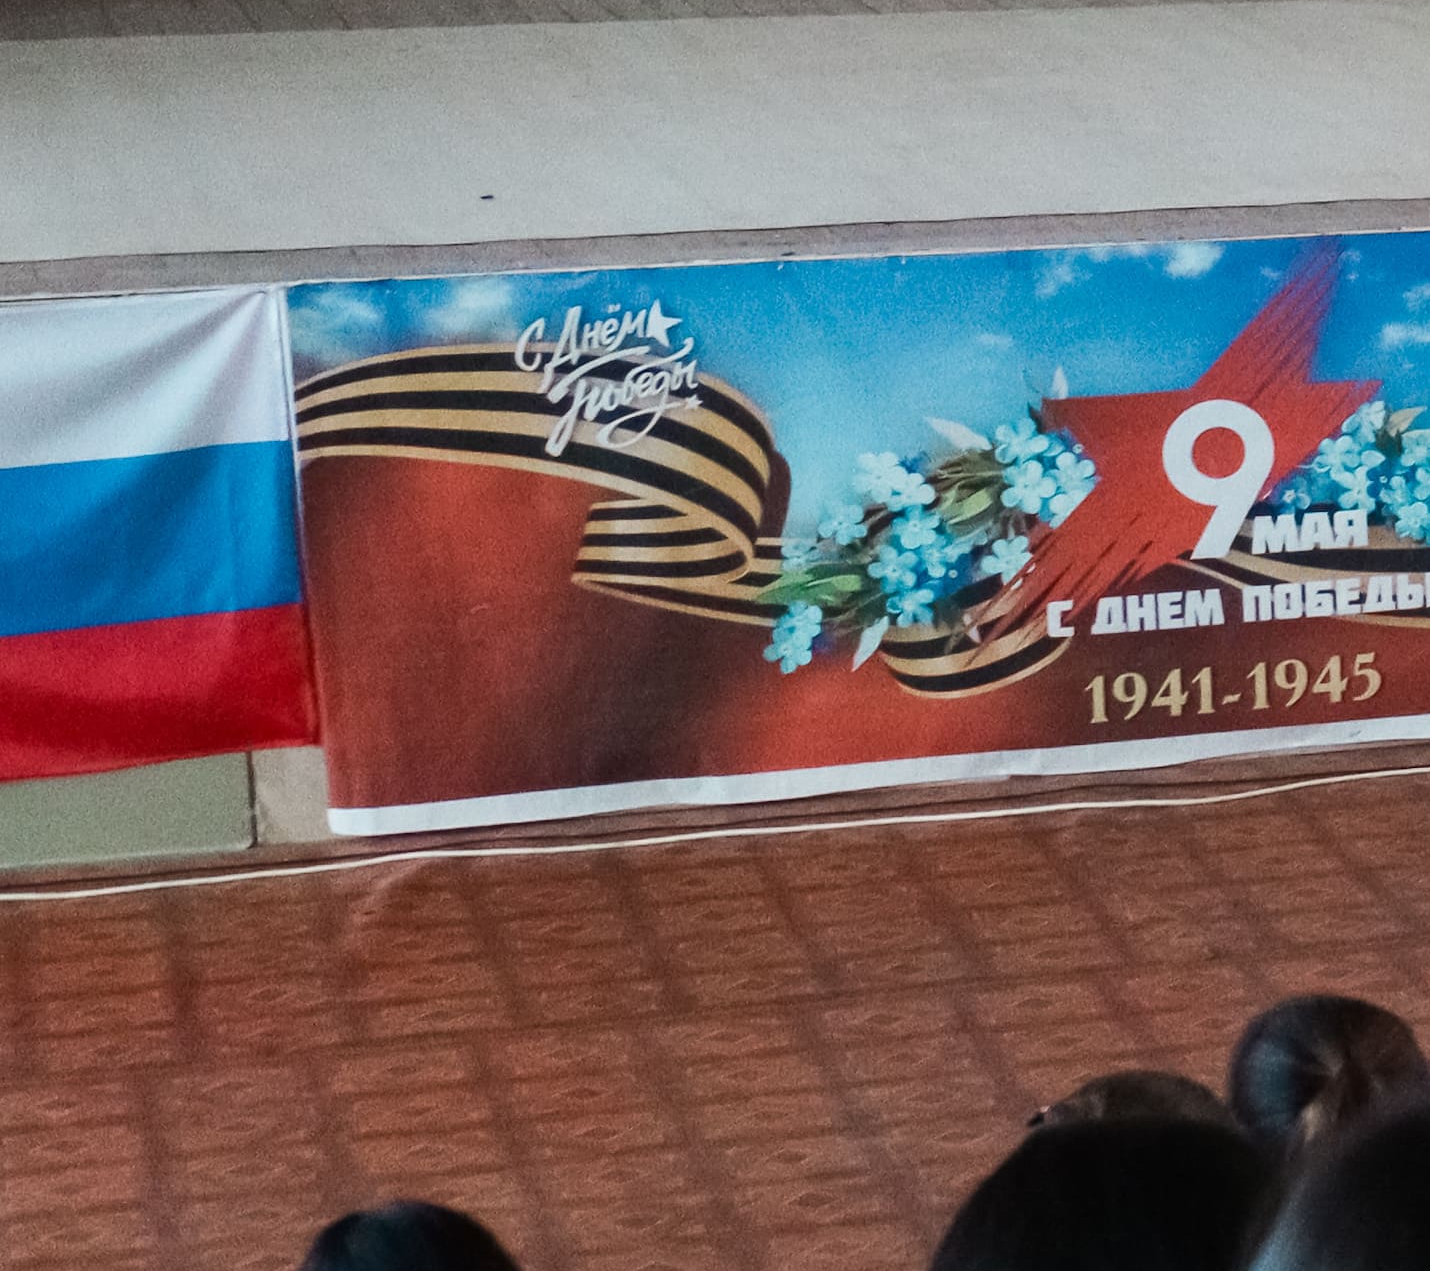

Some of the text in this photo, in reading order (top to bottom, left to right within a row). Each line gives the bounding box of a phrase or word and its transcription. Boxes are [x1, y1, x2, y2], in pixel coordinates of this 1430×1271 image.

[514, 317, 546, 372] С
[1161, 398, 1370, 561] 9 МАЯ
[1045, 598, 1076, 638] С
[1091, 587, 1225, 636] ДНЕМ
[1083, 651, 1383, 725] 1941-1945
